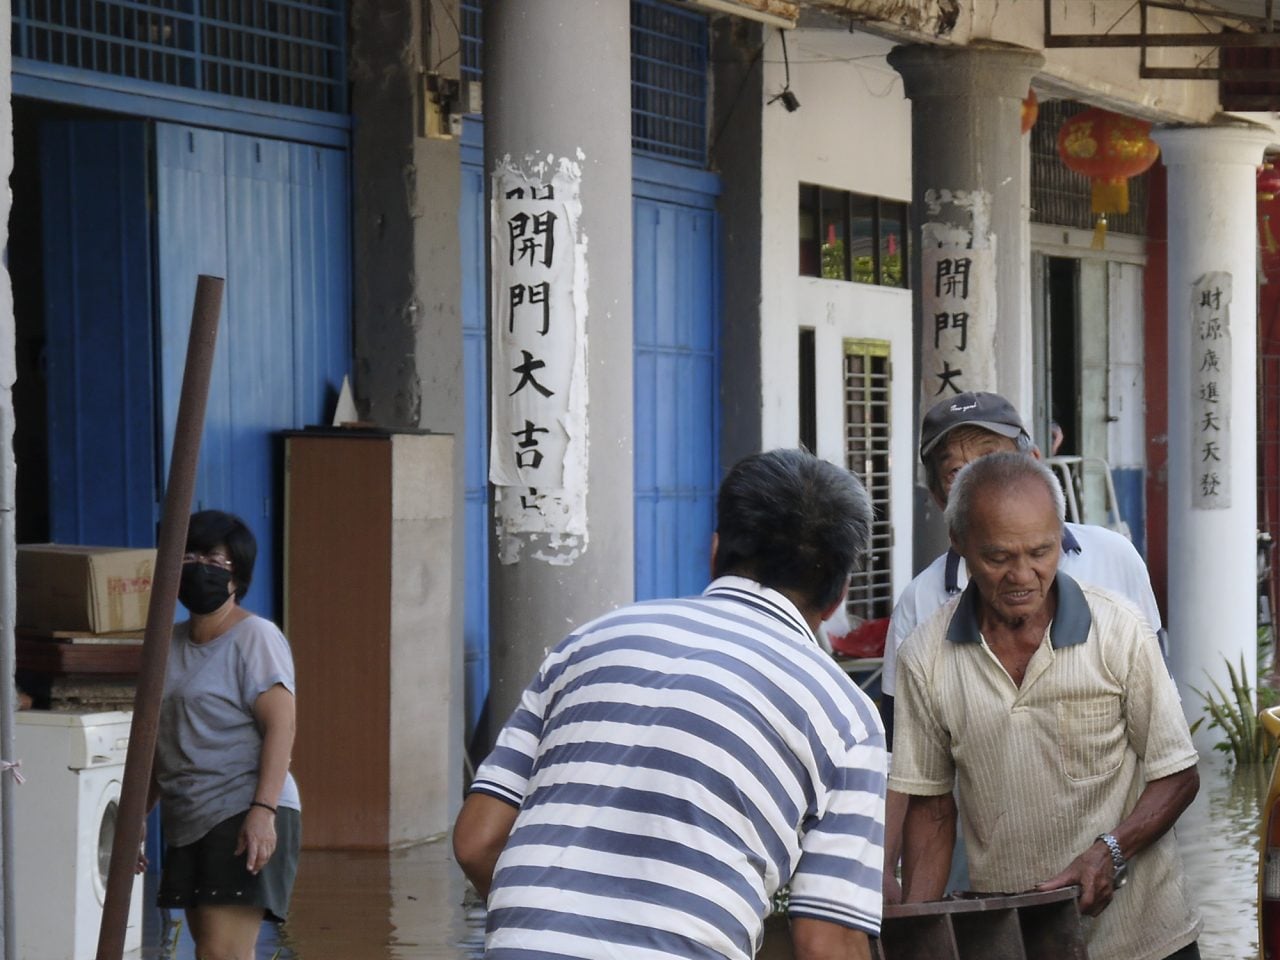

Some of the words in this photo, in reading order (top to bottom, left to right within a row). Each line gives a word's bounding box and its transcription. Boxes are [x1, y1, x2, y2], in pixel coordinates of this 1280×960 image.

[507, 209, 558, 469] 開門大吉
[1200, 287, 1223, 497] 財源廣進天天發
